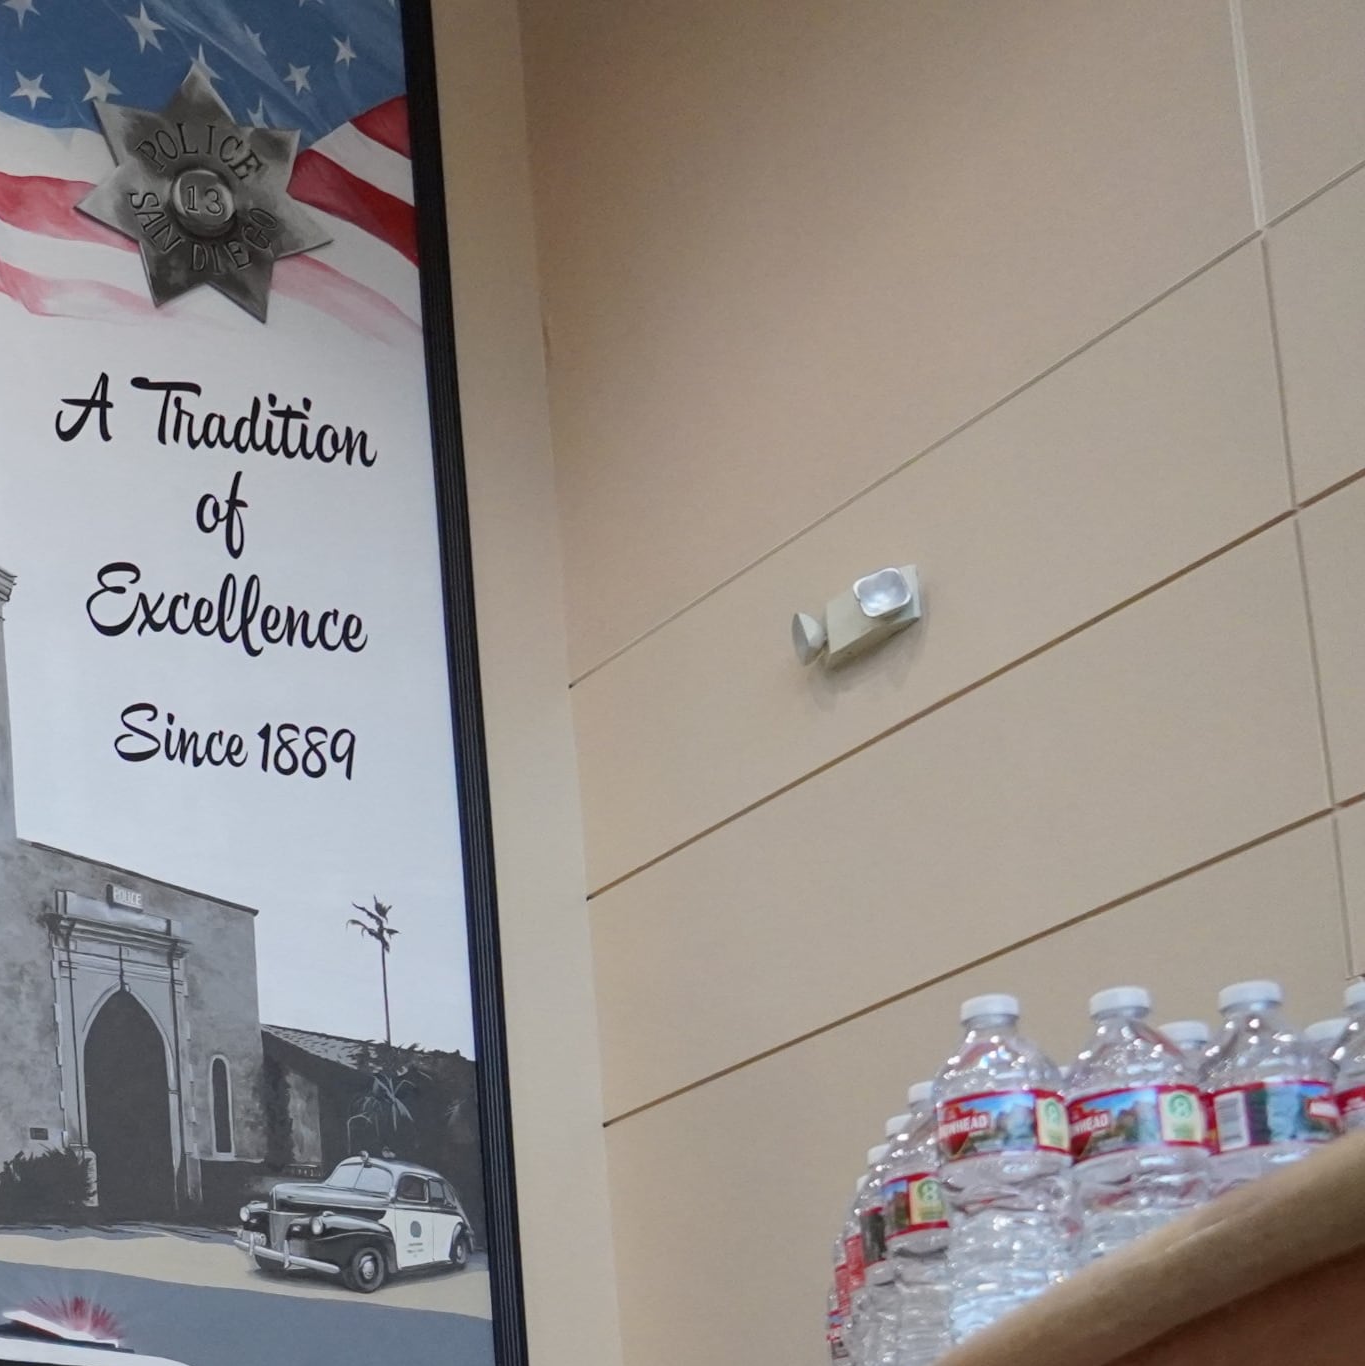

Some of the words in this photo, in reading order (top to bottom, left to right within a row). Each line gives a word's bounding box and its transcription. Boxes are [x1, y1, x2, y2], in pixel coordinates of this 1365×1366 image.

[136, 123, 263, 180] POLICE
[129, 192, 183, 252] SAN
[192, 207, 278, 274] DIEGO
[185, 185, 224, 215] 13
[55, 372, 114, 441] A
[130, 377, 377, 467] Tradition
[196, 471, 249, 559] of
[86, 562, 368, 657] Excellence
[114, 702, 248, 768] Since
[257, 722, 356, 780] 1889
[113, 886, 142, 906] POLICE
